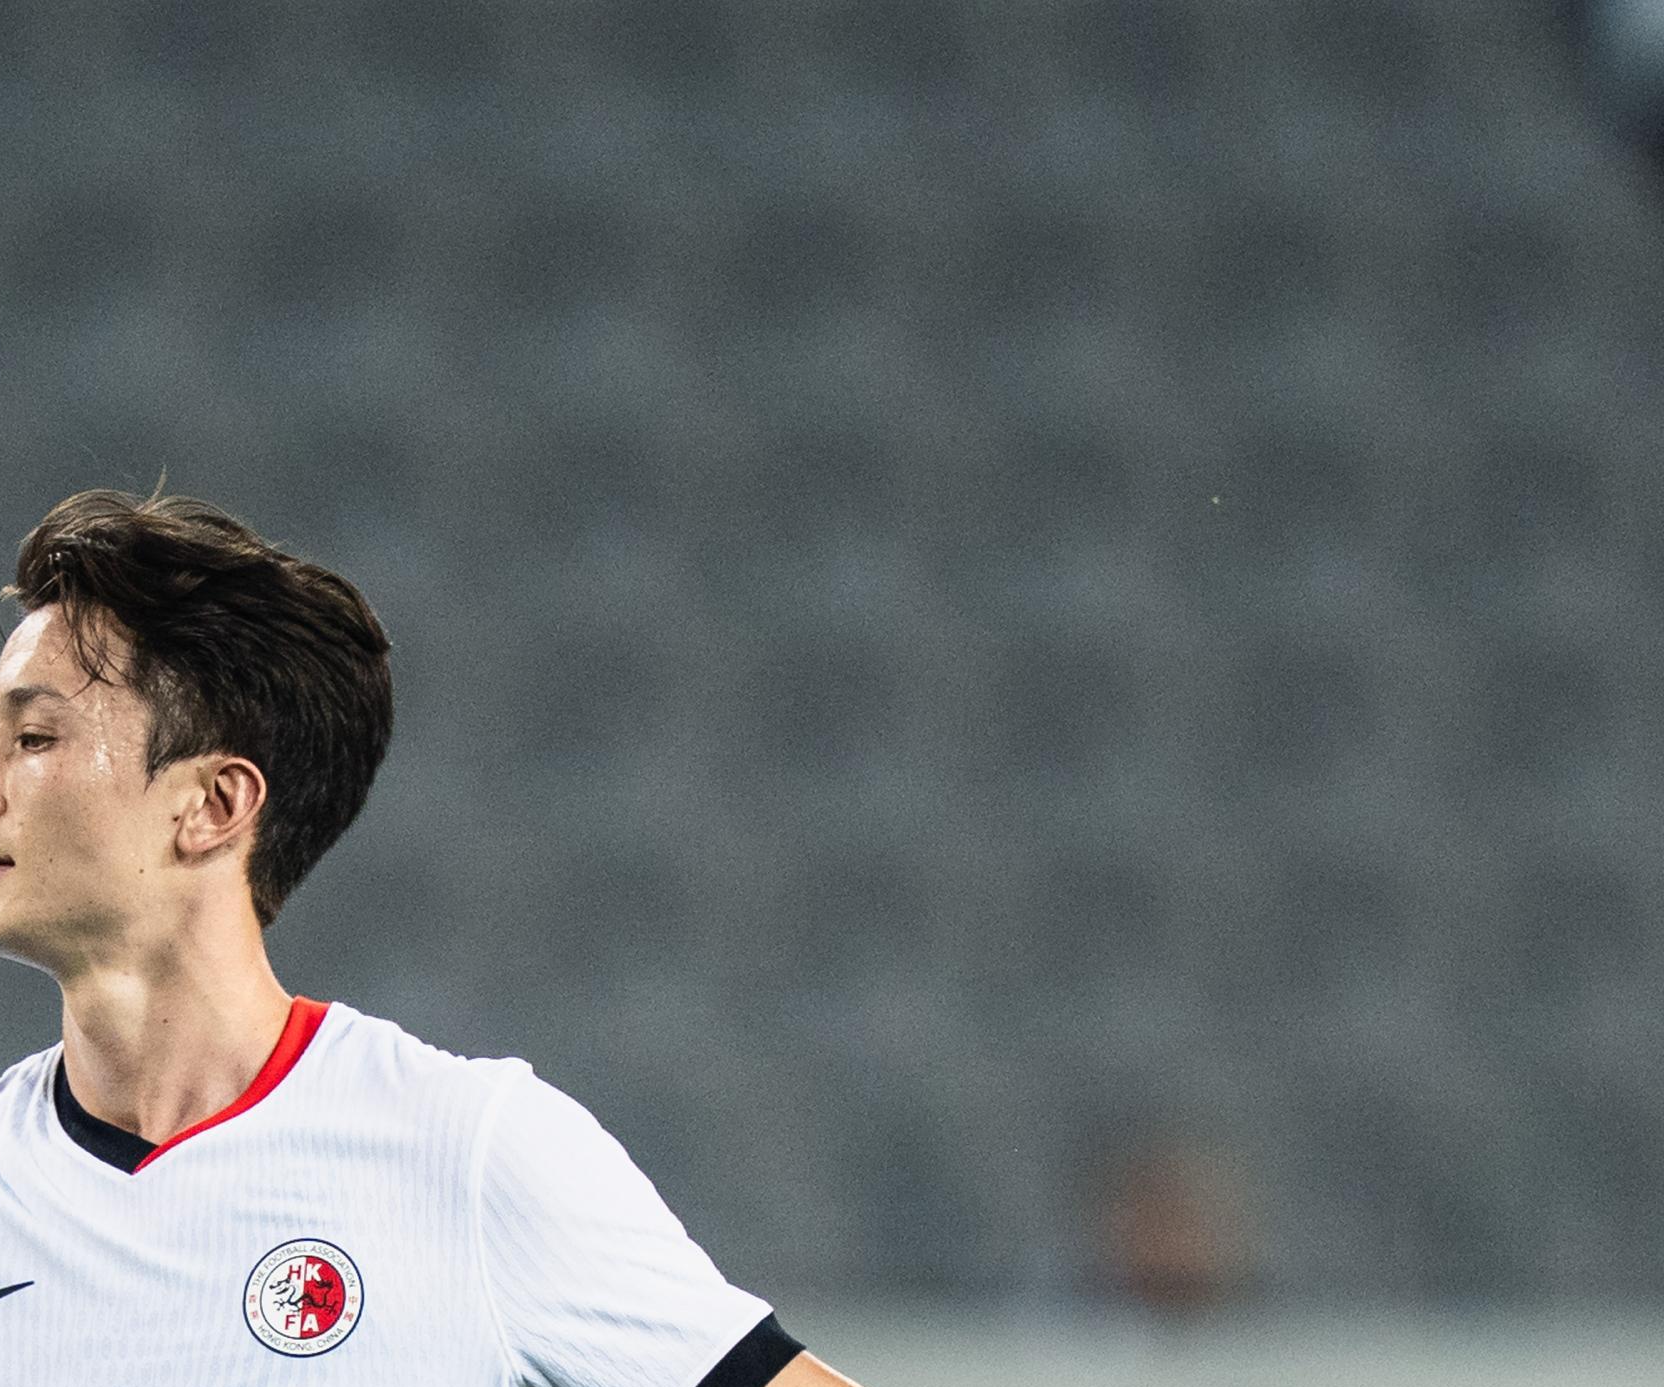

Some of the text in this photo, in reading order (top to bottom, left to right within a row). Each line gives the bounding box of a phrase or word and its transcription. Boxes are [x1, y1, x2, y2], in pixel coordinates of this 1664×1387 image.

[265, 1245, 308, 1270] FOOTBALL
[311, 1245, 356, 1288] ASSOCIATION
[288, 1263, 322, 1281] HK
[284, 1313, 320, 1332] FA
[258, 1323, 282, 1347] HONG
[315, 1326, 344, 1349] CHINA
